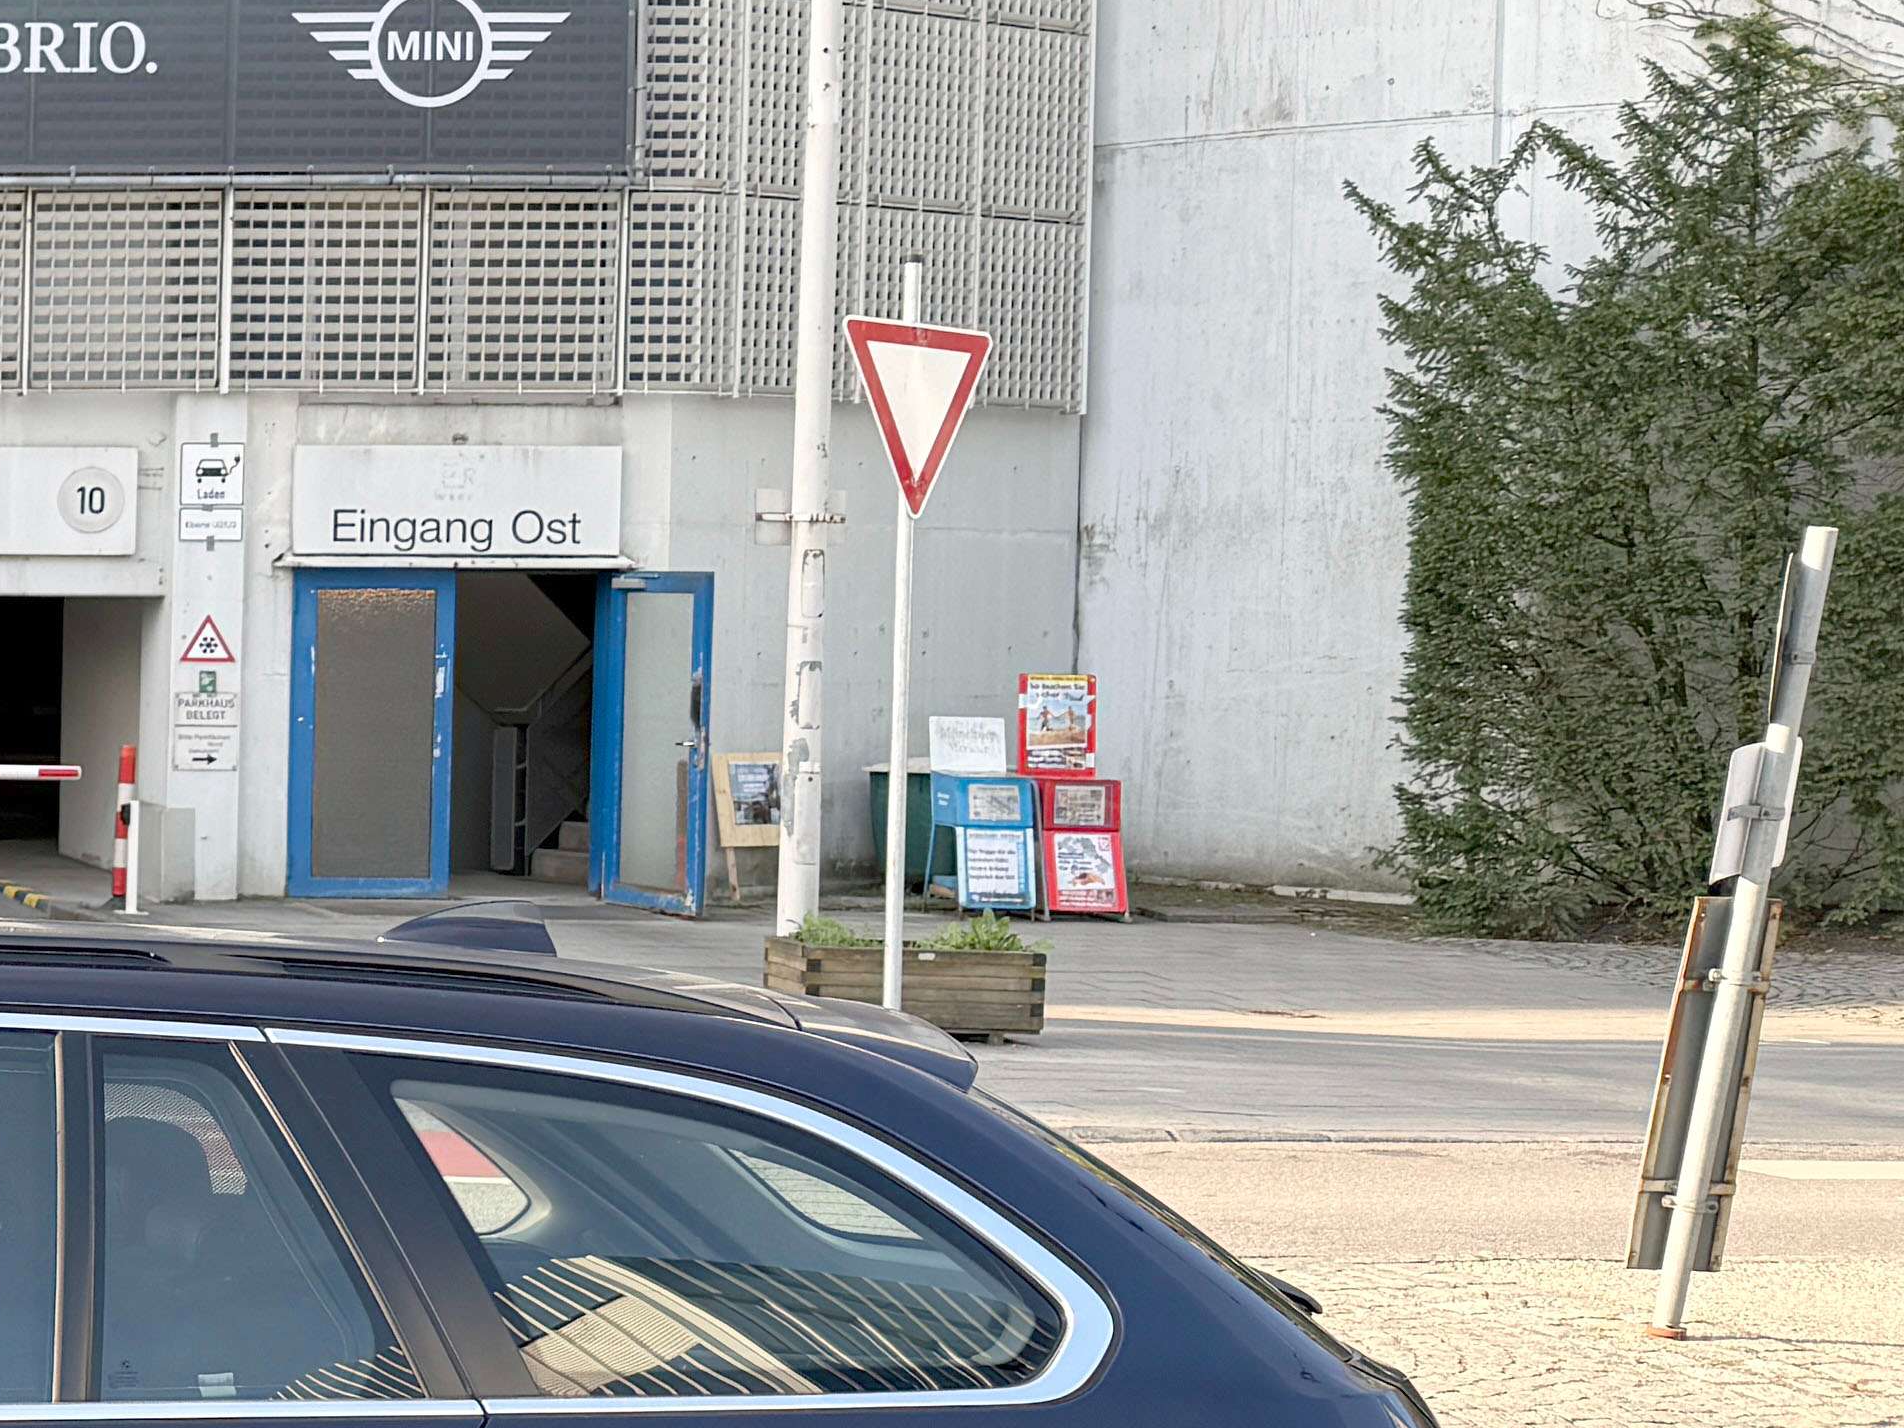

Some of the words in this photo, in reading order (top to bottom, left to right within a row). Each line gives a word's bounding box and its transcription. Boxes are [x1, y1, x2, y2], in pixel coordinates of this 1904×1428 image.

[388, 29, 476, 63] MINI
[77, 487, 104, 514] 10
[197, 489, 225, 499] Laden
[332, 508, 493, 552] Eingang
[512, 510, 581, 544] Ost
[178, 698, 235, 708] PARKHAUS
[186, 710, 226, 720] BELEGT
